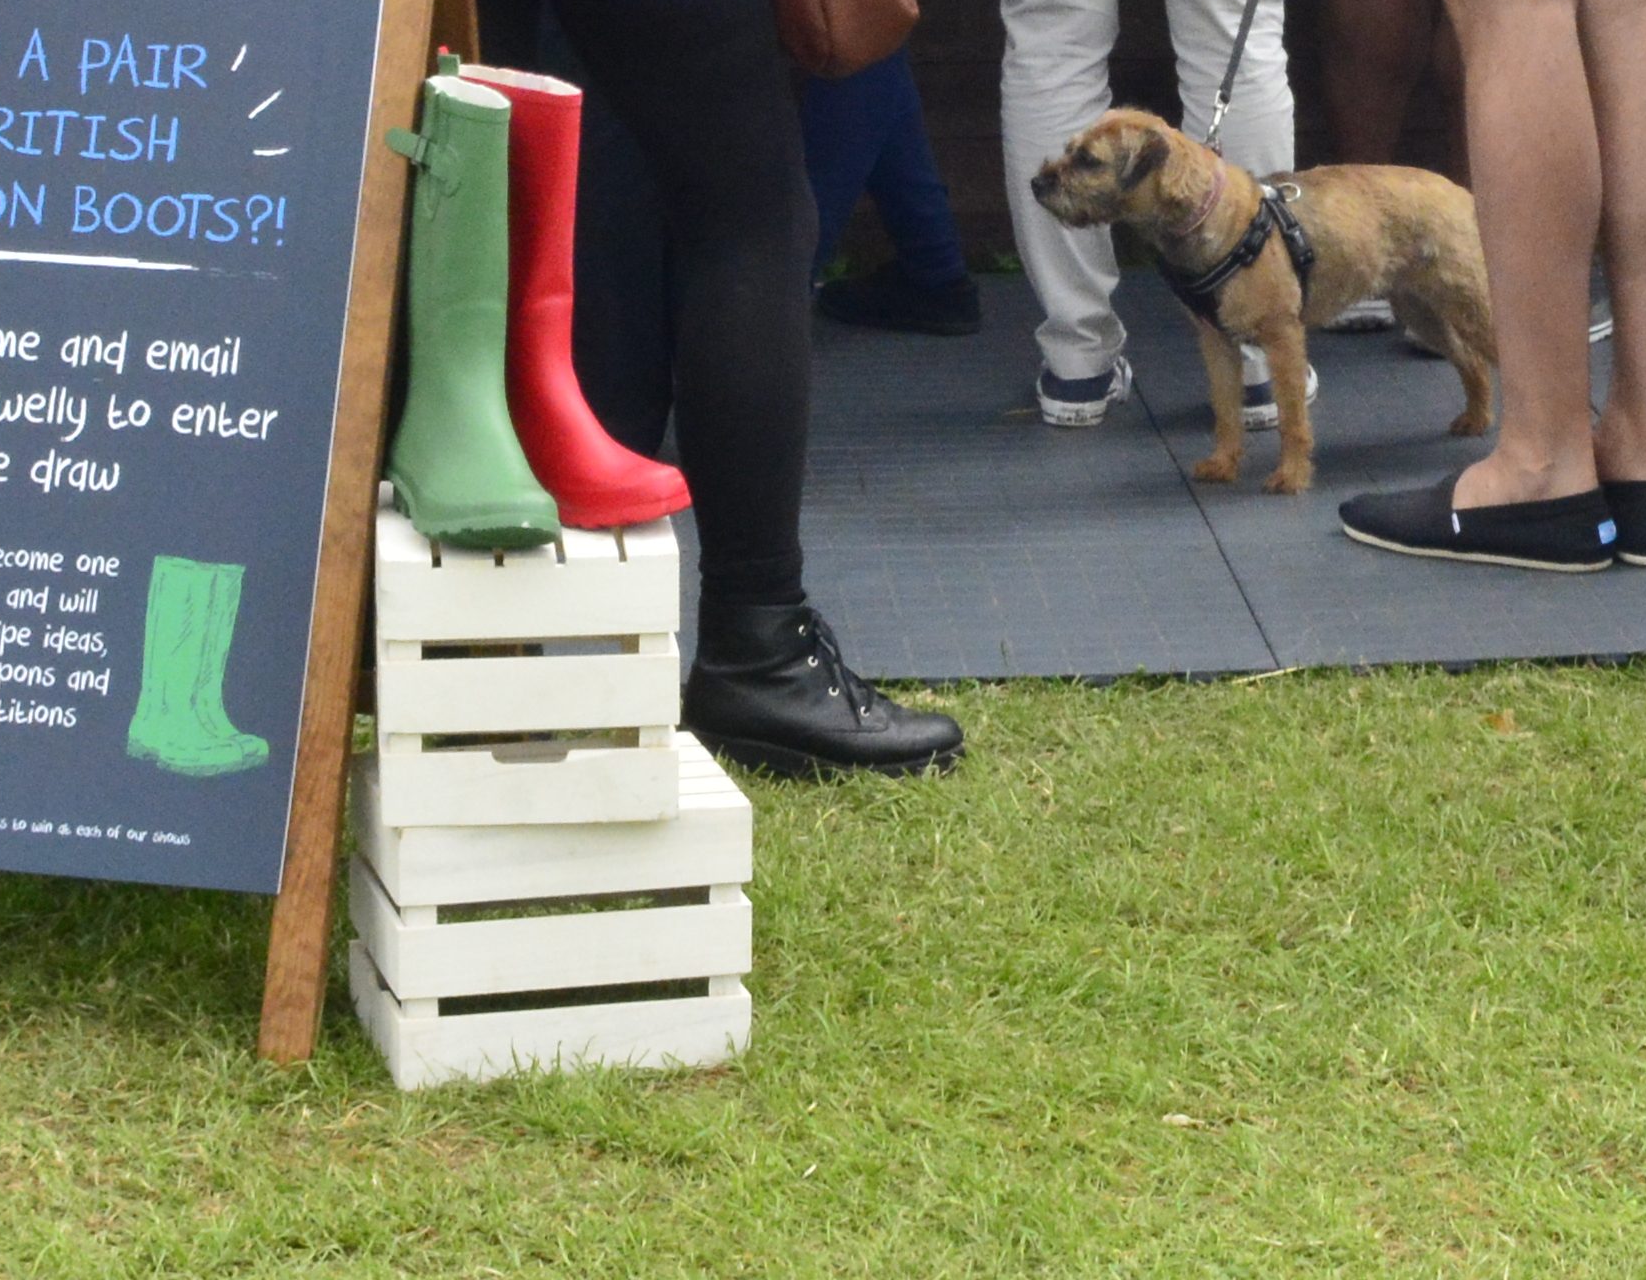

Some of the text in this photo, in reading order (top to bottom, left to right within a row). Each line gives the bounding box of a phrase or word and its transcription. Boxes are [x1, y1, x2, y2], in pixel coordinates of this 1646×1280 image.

[18, 27, 49, 82] A
[78, 33, 207, 95] PAIR
[71, 185, 286, 247] BOOTS?!
[60, 330, 128, 375] and
[145, 336, 241, 377] email
[107, 393, 152, 430] to
[171, 401, 279, 441] enter
[30, 448, 120, 493] draw
[75, 554, 120, 577] one
[6, 586, 50, 614] and
[58, 588, 99, 613] will
[43, 623, 108, 658] ideas,
[67, 667, 111, 696] and
[12, 818, 27, 830] to
[31, 819, 53, 834] win
[58, 822, 72, 835] at
[76, 824, 102, 838] each
[107, 824, 120, 839] of
[127, 828, 147, 842] our
[152, 831, 190, 846] shows
